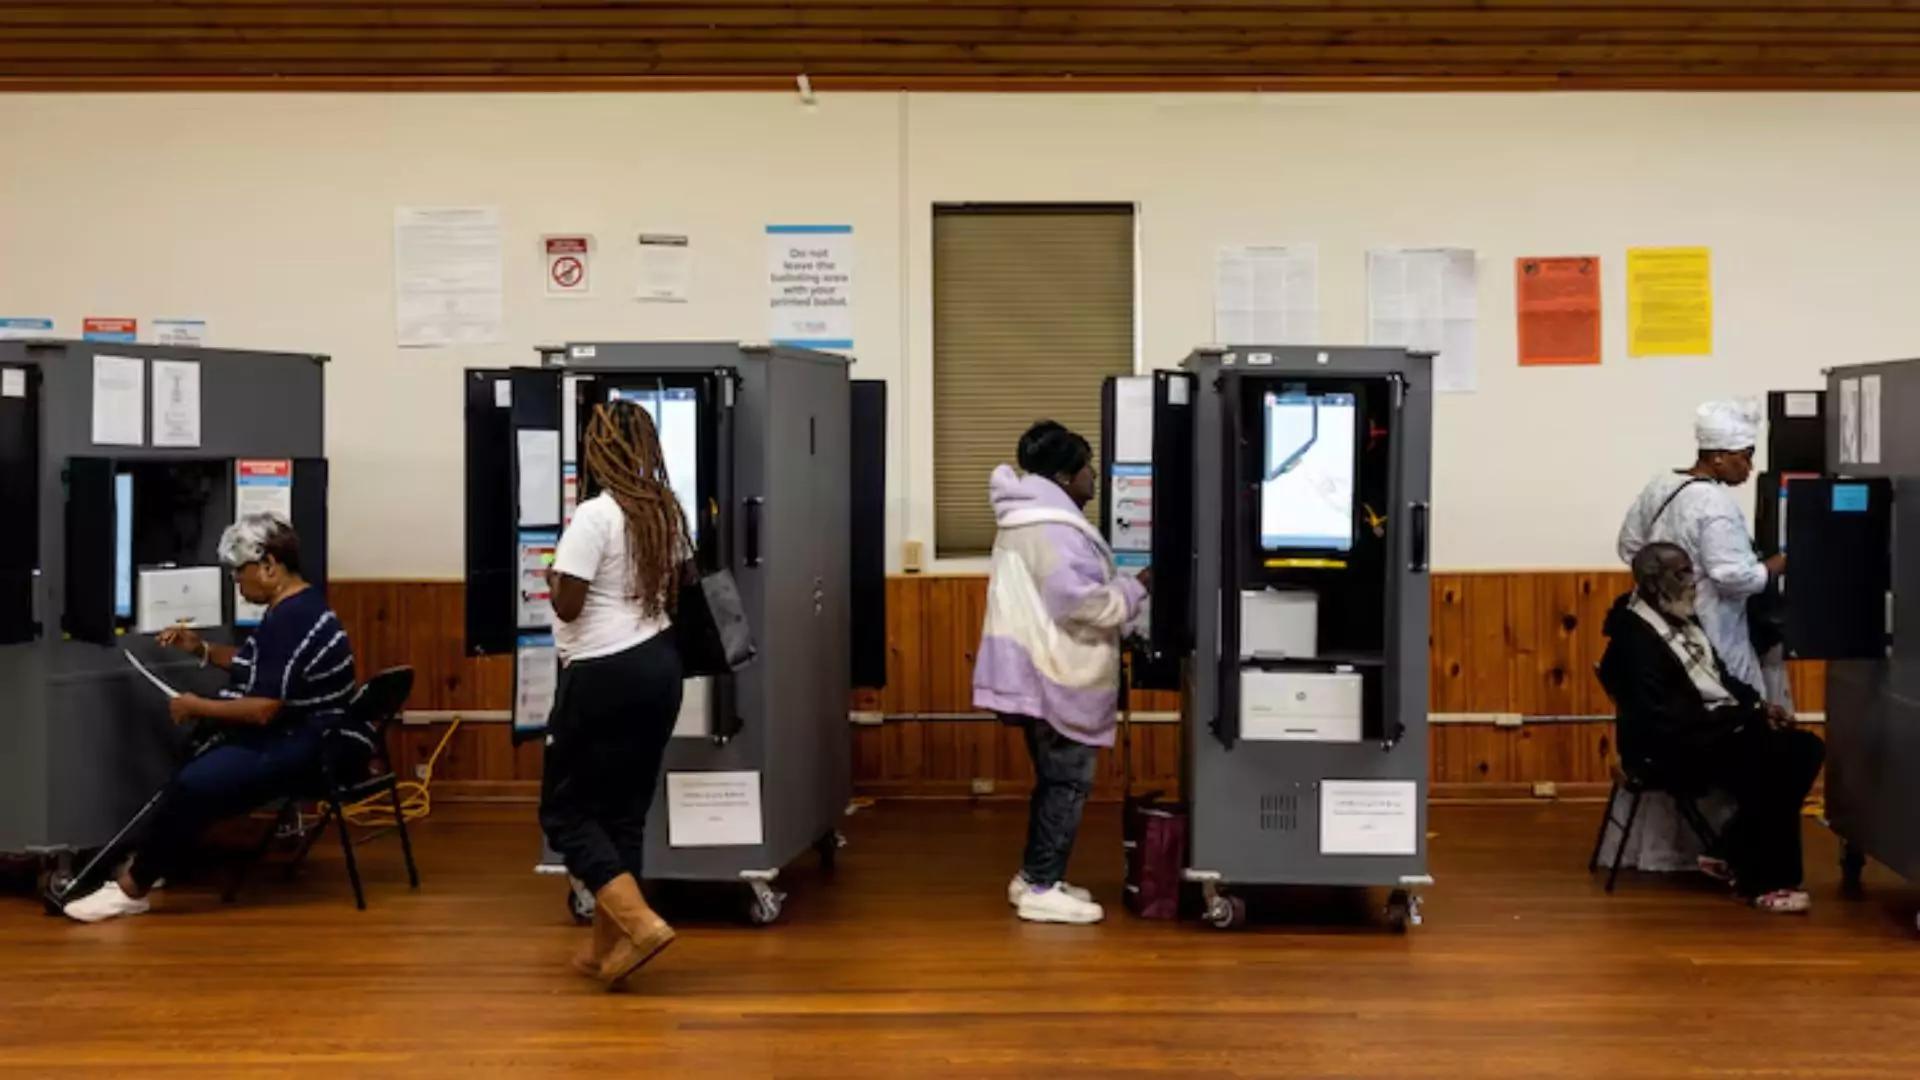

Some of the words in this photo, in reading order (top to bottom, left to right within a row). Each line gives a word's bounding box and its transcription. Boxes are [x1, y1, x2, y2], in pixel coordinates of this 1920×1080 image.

[789, 248, 806, 258] Do
[809, 248, 828, 258] not
[783, 261, 813, 270] leave
[816, 261, 835, 270] the
[823, 274, 849, 282] area
[783, 286, 808, 294] with
[810, 287, 836, 296] your
[770, 297, 811, 308] printed
